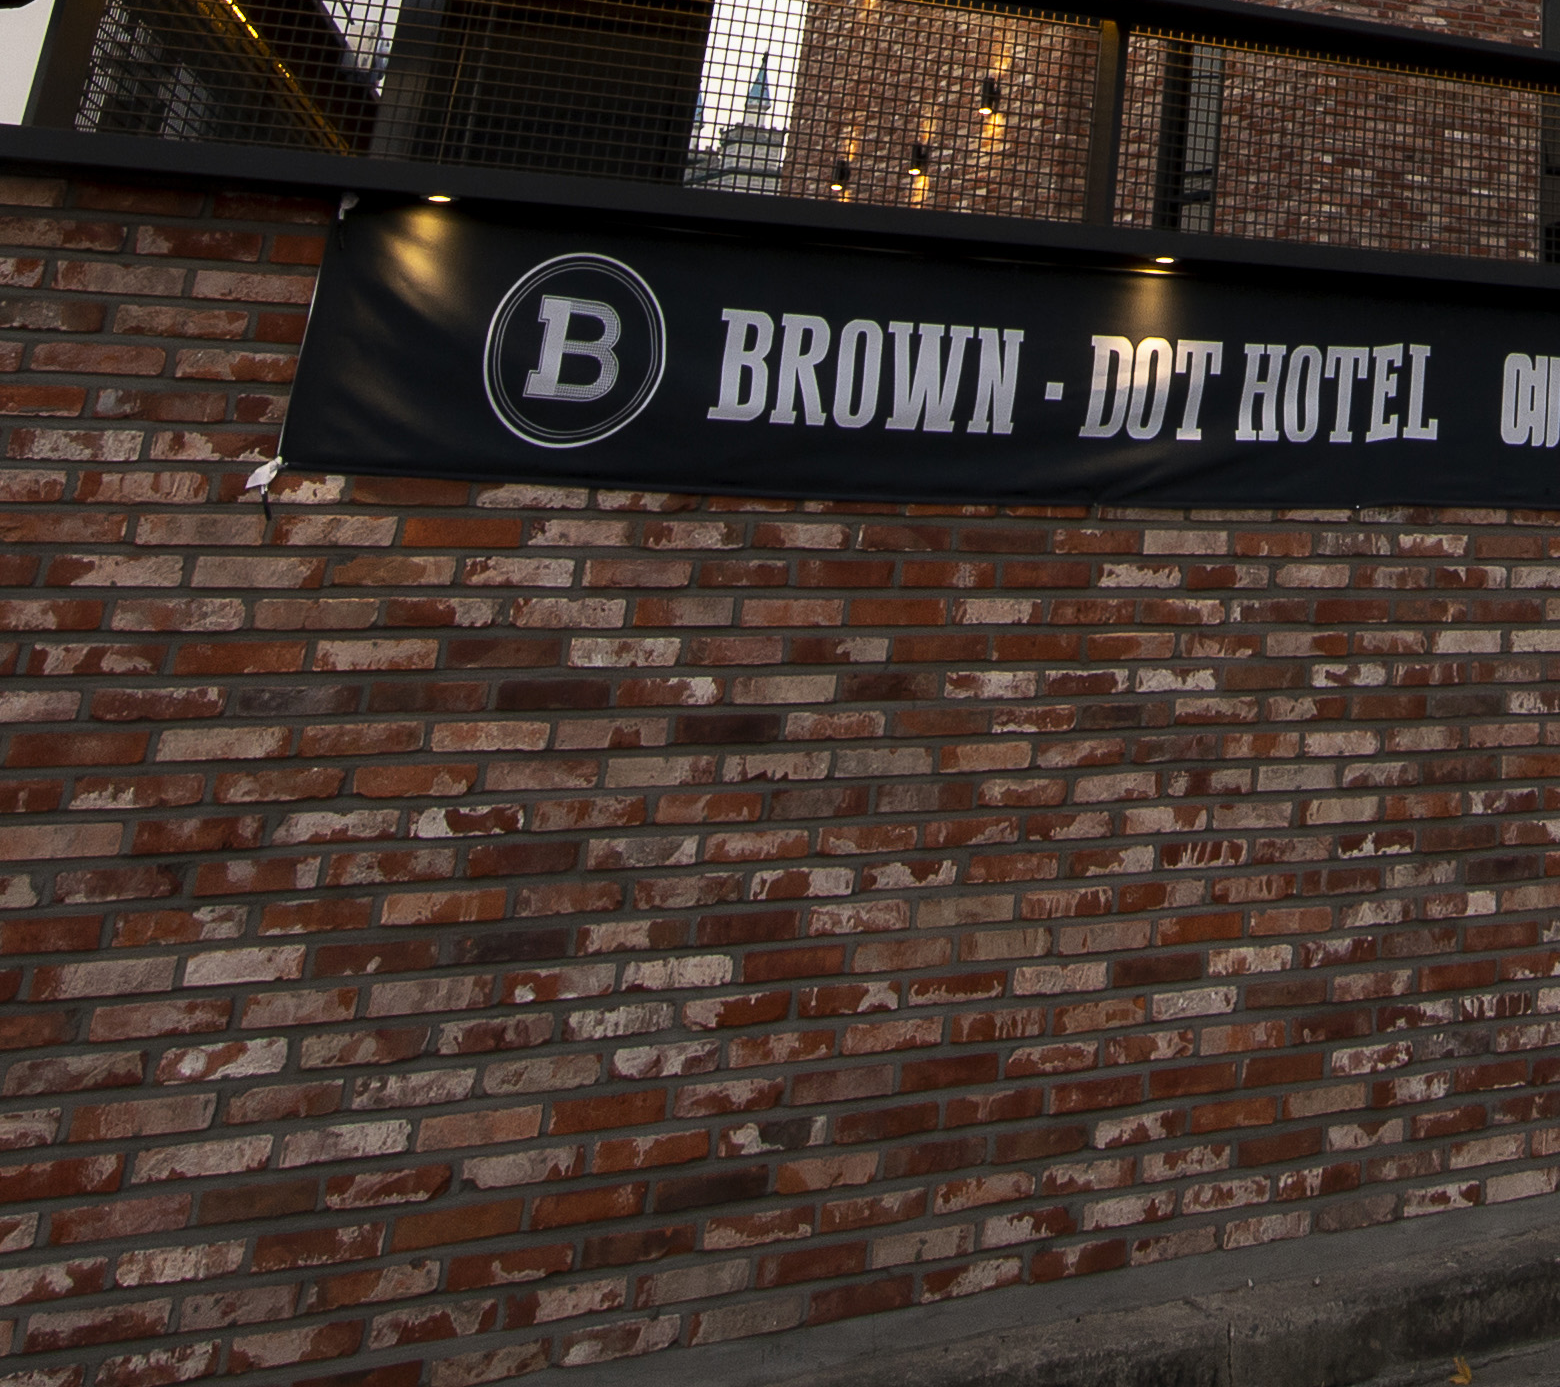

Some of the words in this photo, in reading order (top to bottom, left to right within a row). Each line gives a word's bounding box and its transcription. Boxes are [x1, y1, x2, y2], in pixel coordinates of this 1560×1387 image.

[523, 296, 620, 402] B
[707, 308, 1025, 434] BROWN
[1080, 335, 1220, 441] DOT
[1237, 342, 1439, 443] HOTEL
